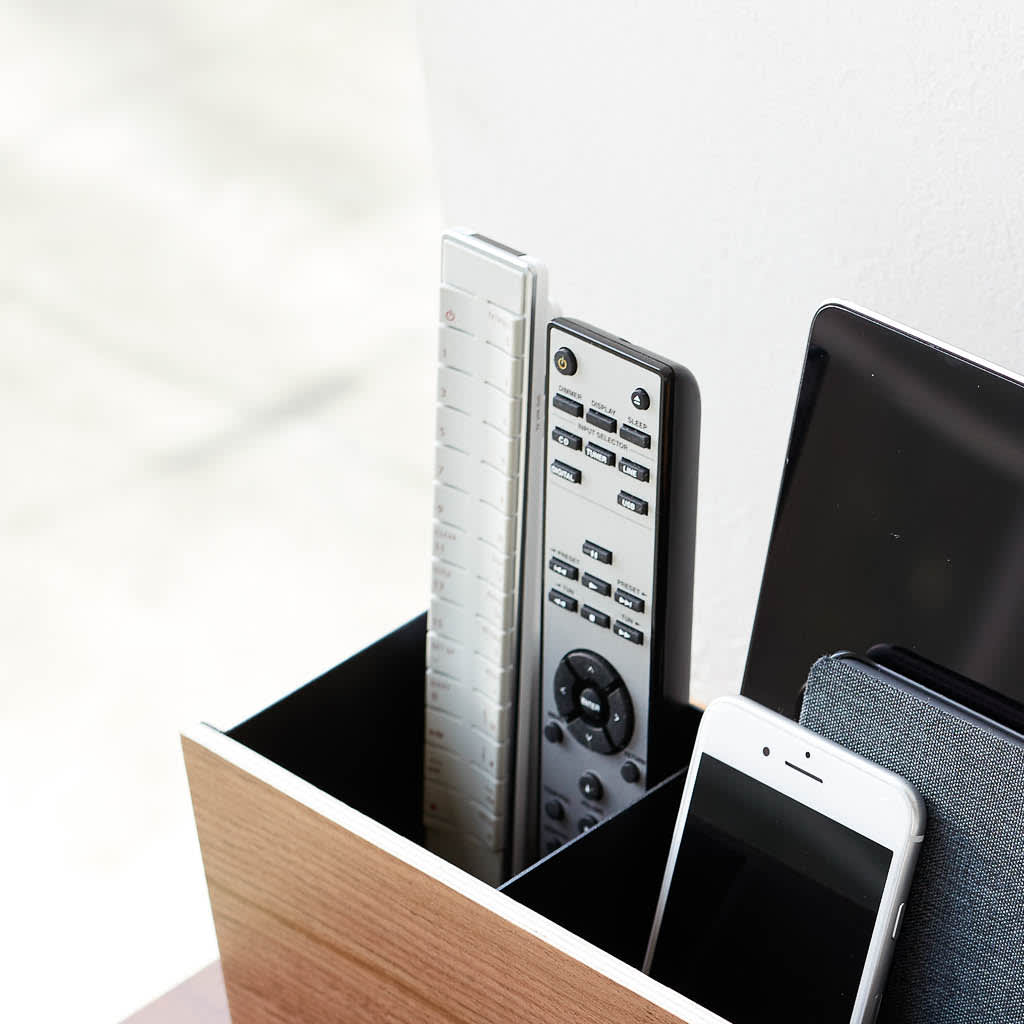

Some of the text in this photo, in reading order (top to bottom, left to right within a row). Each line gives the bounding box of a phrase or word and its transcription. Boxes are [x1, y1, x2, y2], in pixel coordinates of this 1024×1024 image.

[592, 400, 616, 415] DISPLAY
[627, 416, 648, 429] SLEEP
[559, 435, 570, 446] CD
[578, 423, 629, 450] INPUT SELECTOR
[586, 448, 608, 464] TUNER
[623, 464, 638, 478] LINE
[621, 499, 636, 511] USB
[617, 579, 641, 594] PRESET
